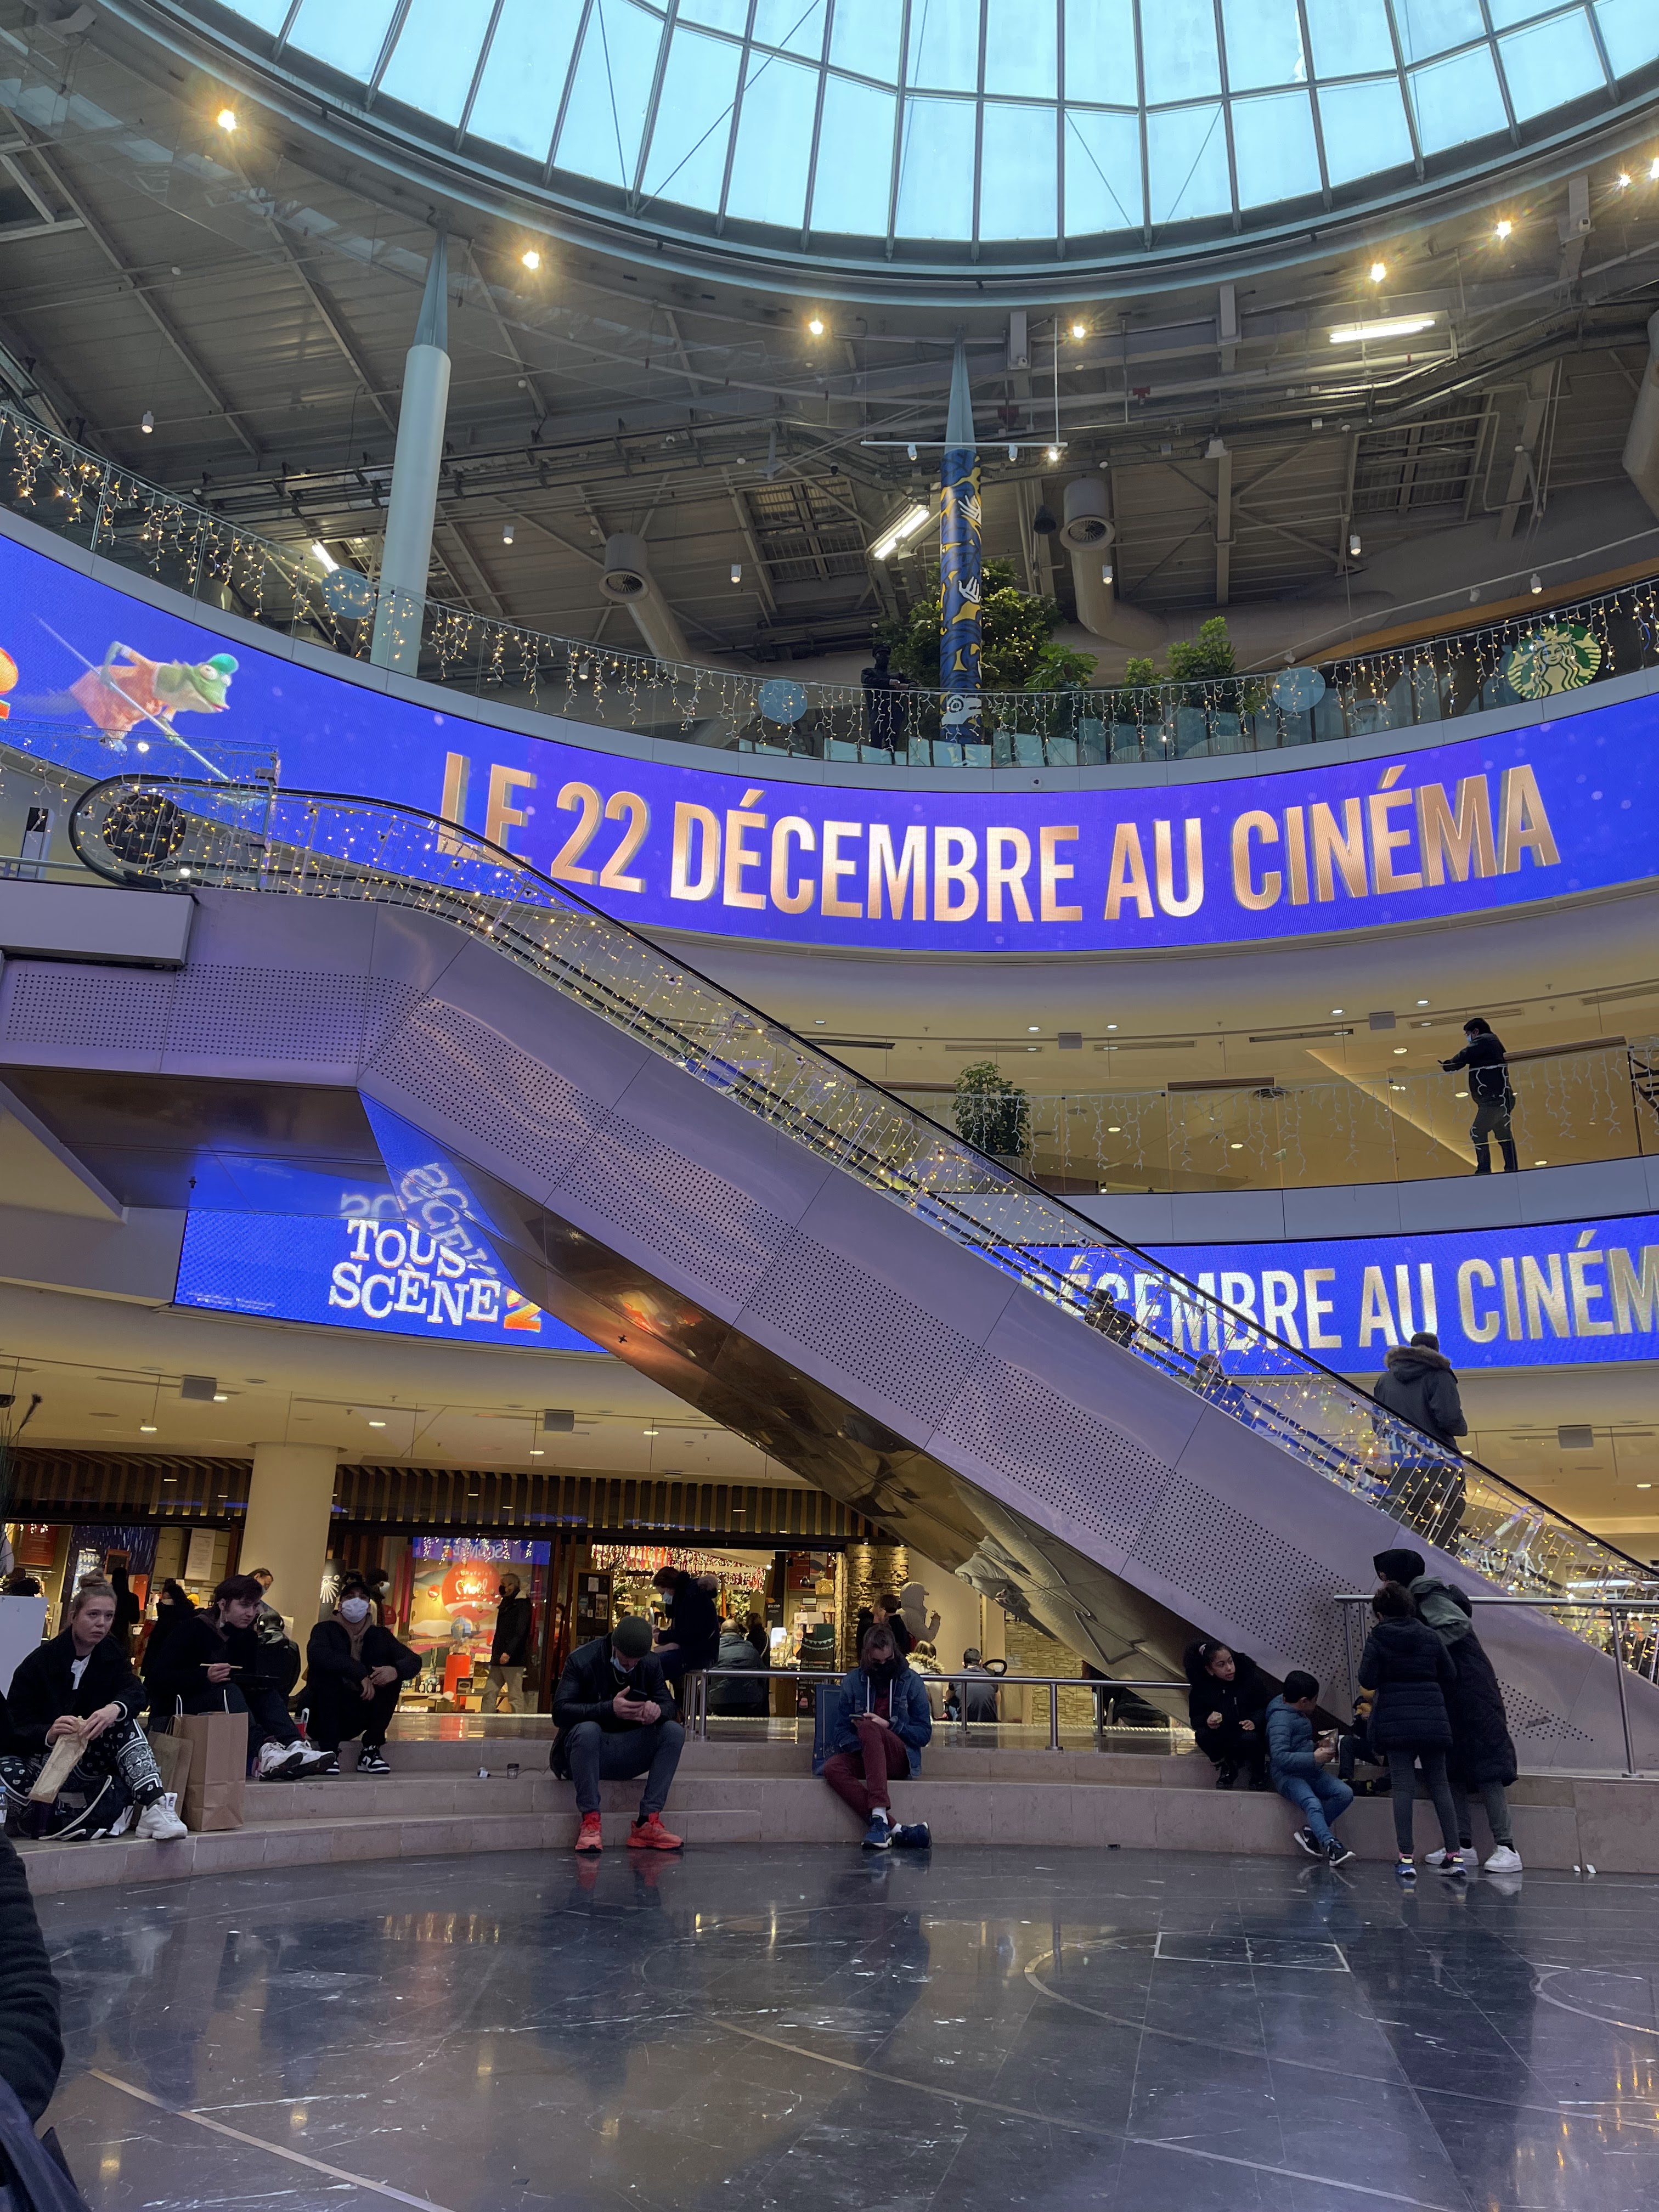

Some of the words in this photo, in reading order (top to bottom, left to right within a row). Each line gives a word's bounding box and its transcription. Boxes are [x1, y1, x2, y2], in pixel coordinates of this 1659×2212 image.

[437, 751, 537, 870] LE
[550, 781, 648, 893] 22
[669, 788, 1083, 923] DÉCEMBRE
[1104, 817, 1205, 921] AU
[1232, 764, 1562, 911] CINÉMA
[347, 1219, 467, 1279] TOUS
[329, 1261, 501, 1326] SCÈNE
[503, 1288, 541, 1334] 2
[1359, 1263, 1438, 1348] AU
